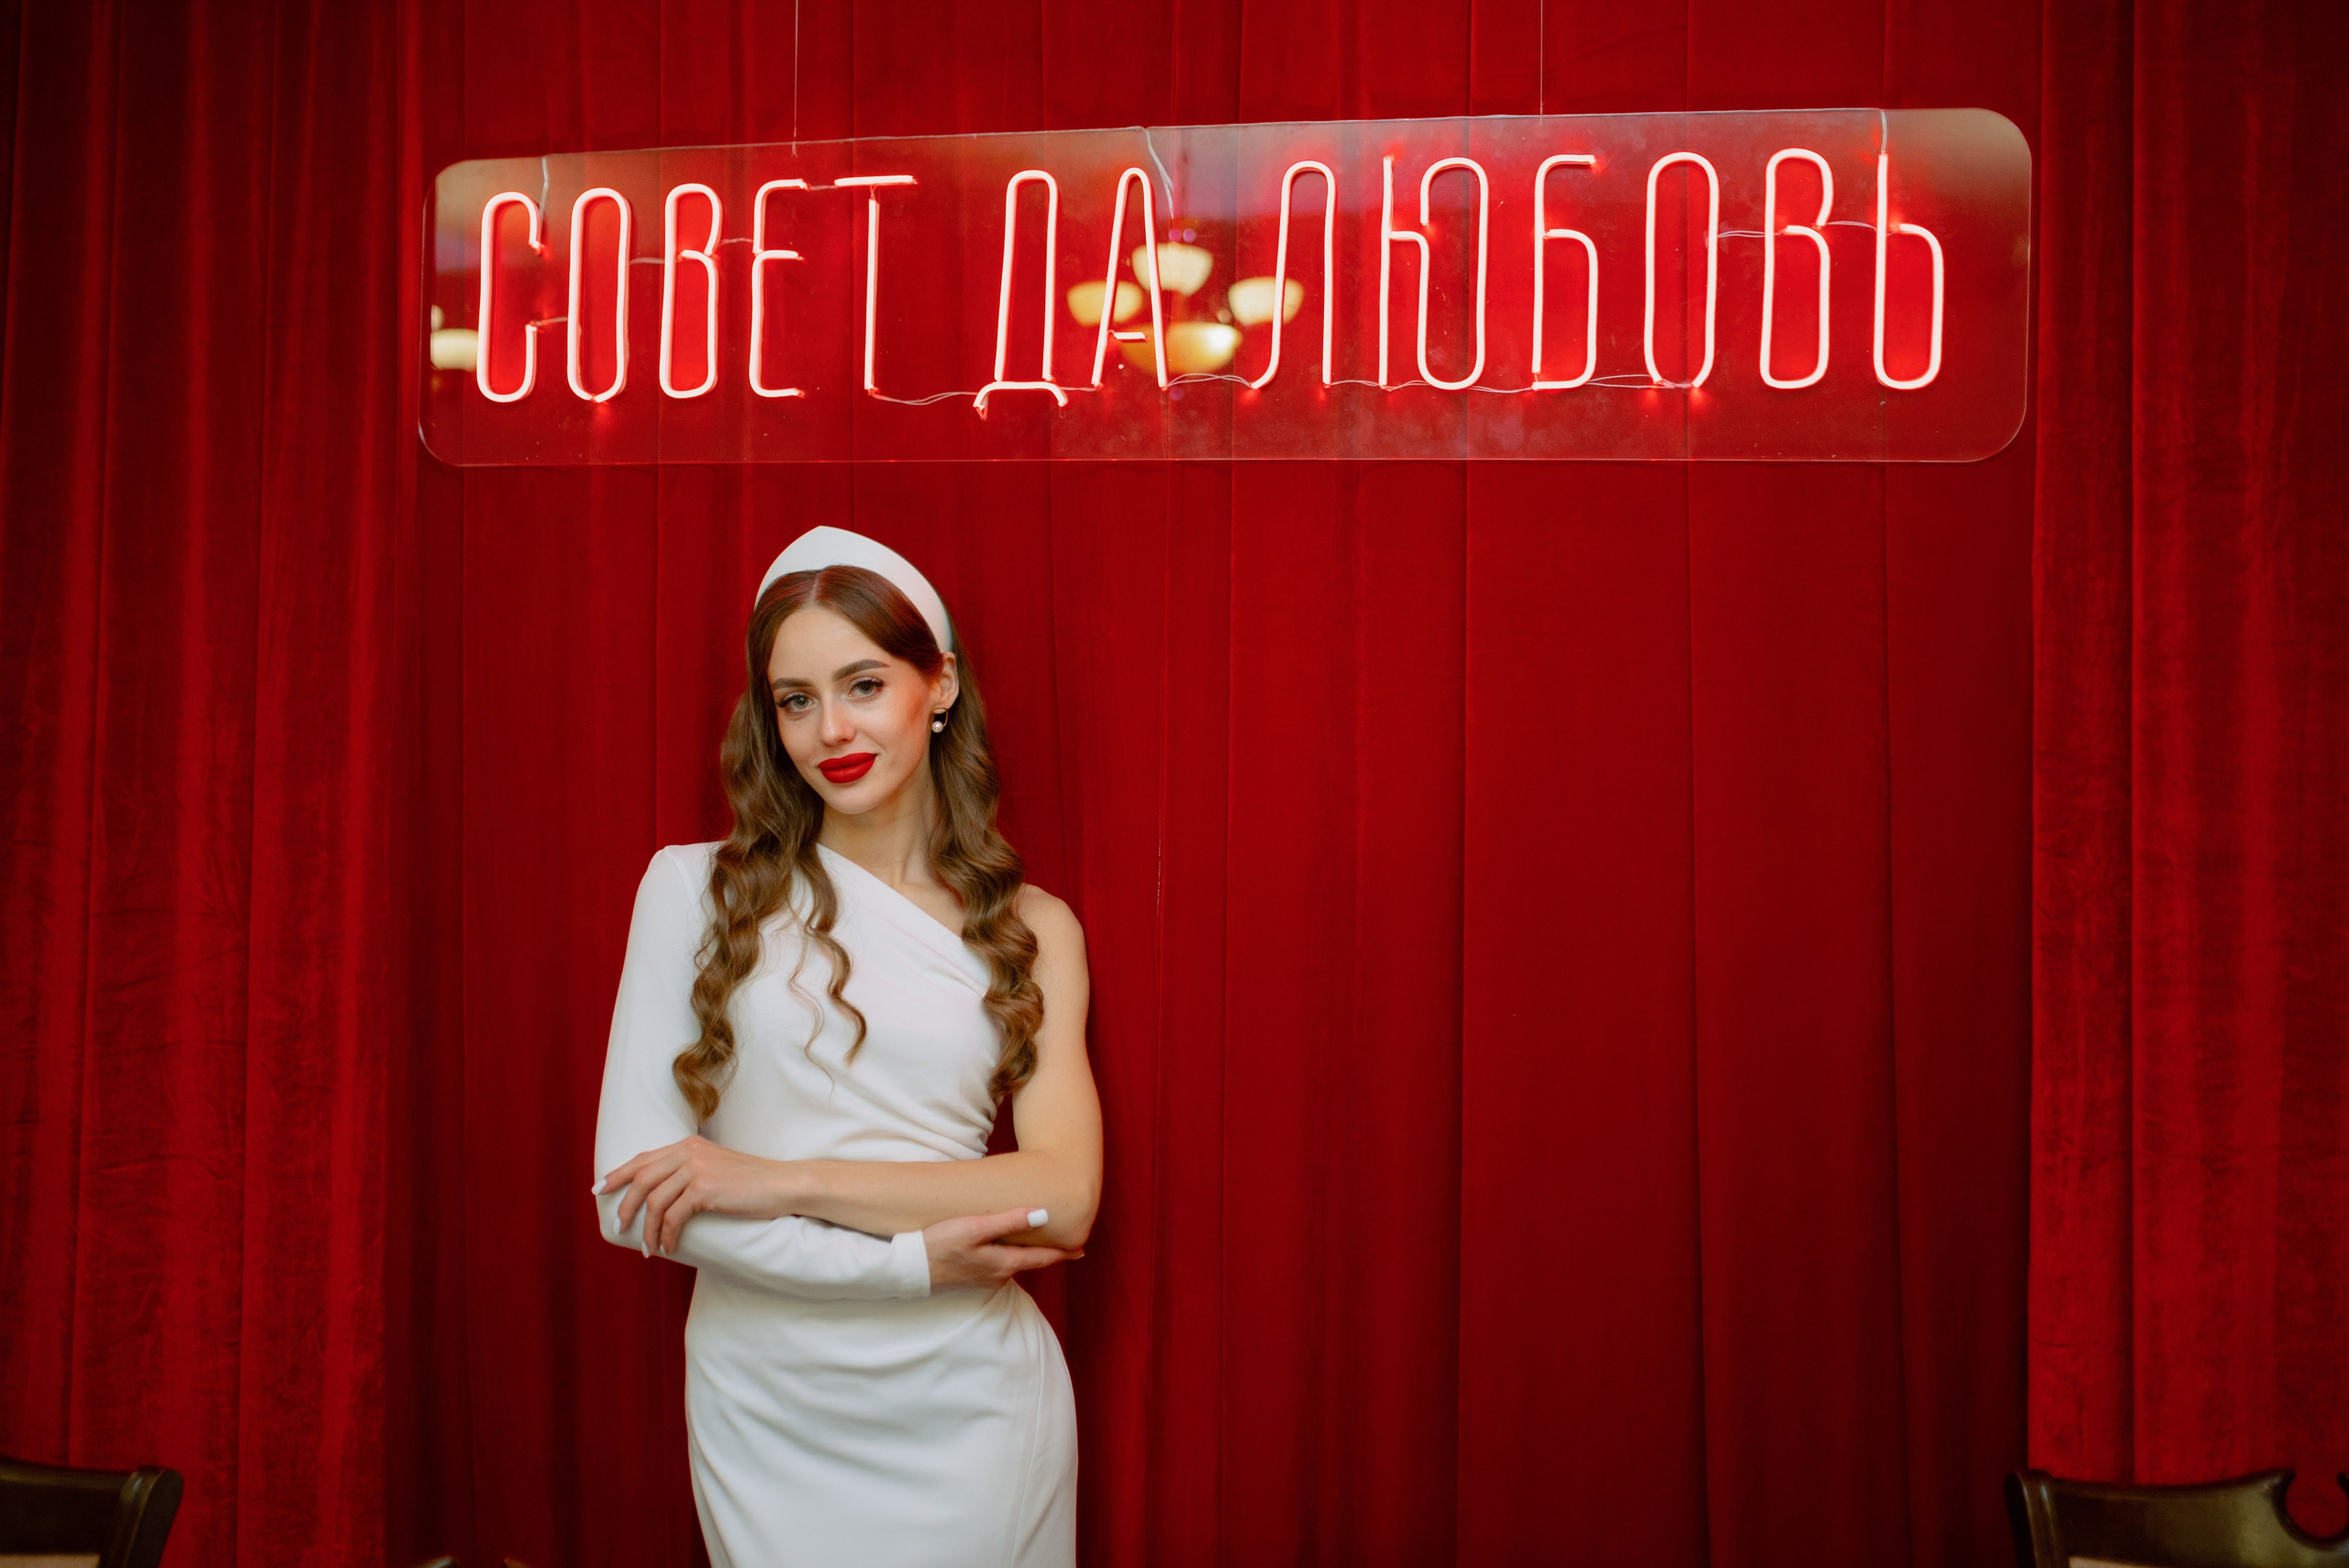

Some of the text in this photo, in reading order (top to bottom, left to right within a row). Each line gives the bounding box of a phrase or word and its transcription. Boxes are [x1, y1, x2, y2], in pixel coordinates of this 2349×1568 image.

[475, 147, 1945, 417] СОВЕТ ДА ЛЮБОВЬ
